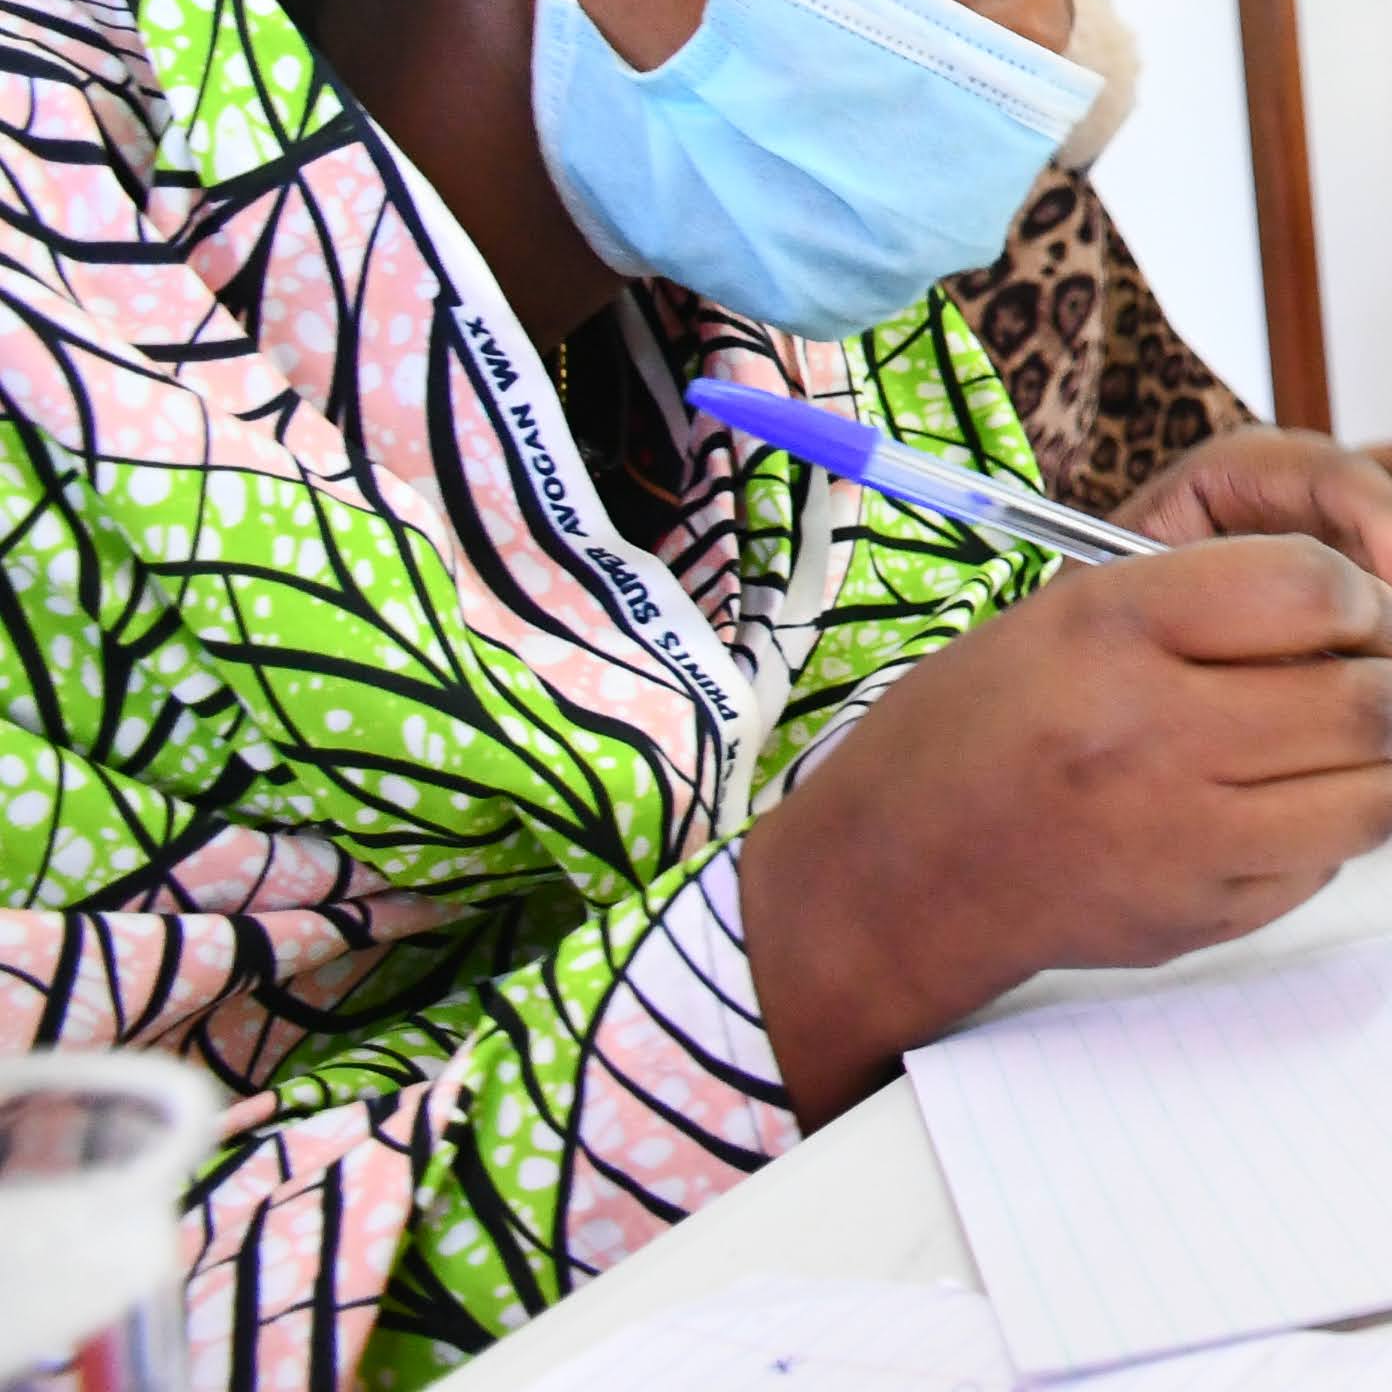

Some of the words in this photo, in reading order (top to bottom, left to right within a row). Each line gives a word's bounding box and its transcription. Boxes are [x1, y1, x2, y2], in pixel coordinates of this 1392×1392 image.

[465, 316, 520, 392] WAX
[511, 401, 589, 538] AVOGAN
[586, 547, 660, 625] SUPER
[655, 631, 739, 722] PRINTS
